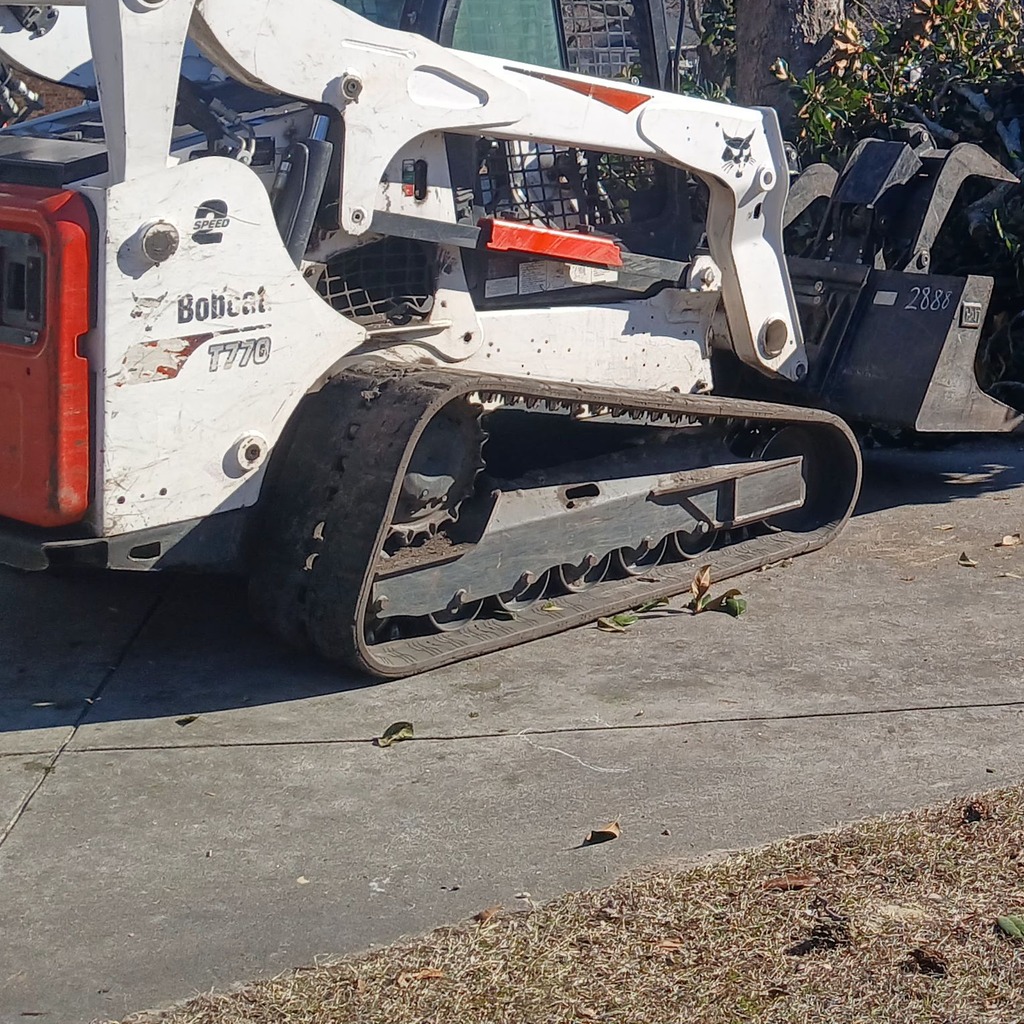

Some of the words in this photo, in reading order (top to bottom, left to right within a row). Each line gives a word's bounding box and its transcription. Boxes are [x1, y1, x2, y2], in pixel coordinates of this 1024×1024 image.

[193, 219, 230, 230] SPEED
[177, 286, 266, 324] Bobcat
[904, 287, 952, 311] 2888
[208, 337, 272, 372] T770
